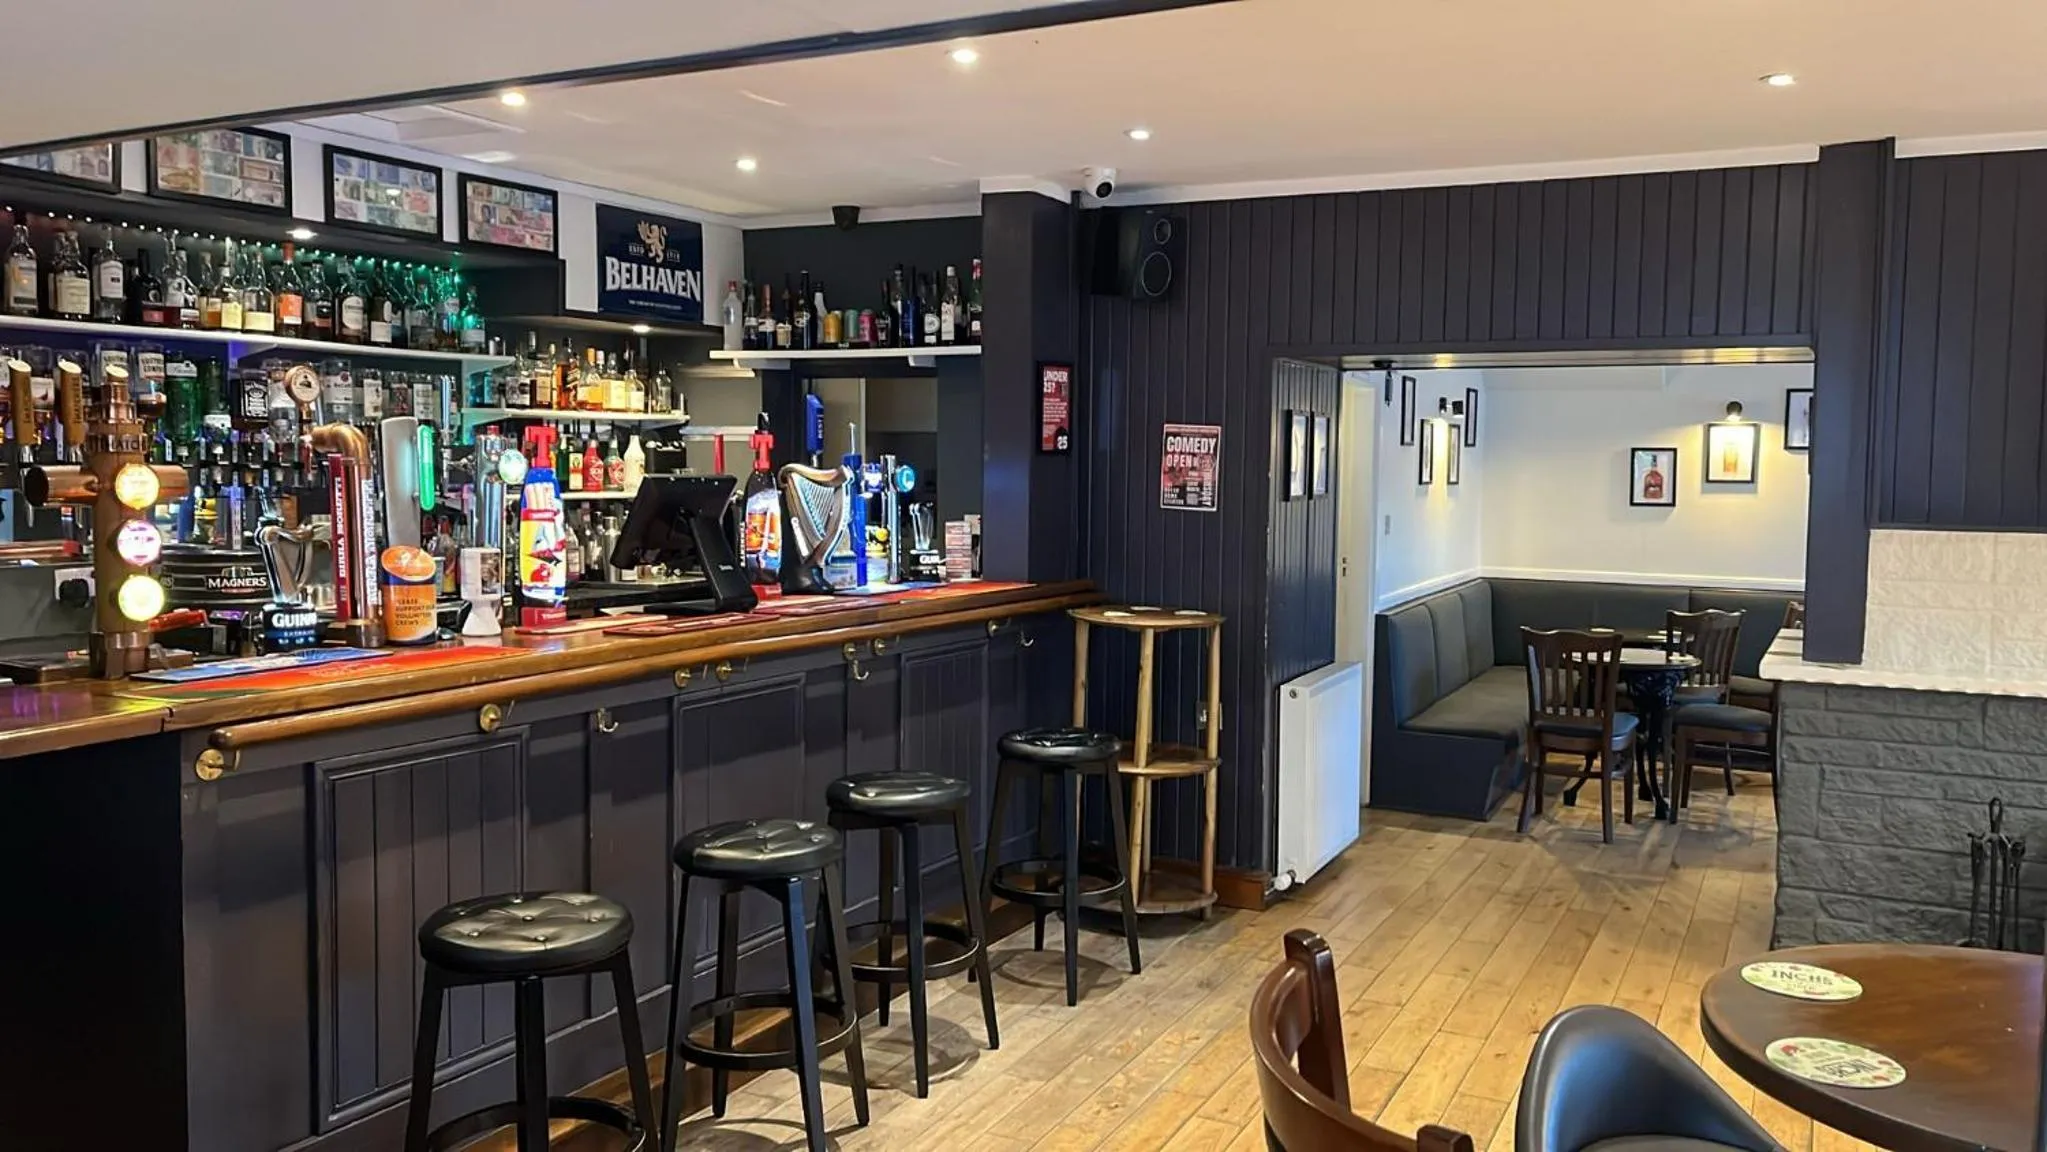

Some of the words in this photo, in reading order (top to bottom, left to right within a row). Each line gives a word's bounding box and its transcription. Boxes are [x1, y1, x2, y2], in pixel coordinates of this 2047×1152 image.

[605, 256, 701, 302] BELHAVEN
[1166, 436, 1217, 454] COMEDY
[1166, 454, 1192, 467] OPEN
[208, 577, 267, 589] MAGNERS
